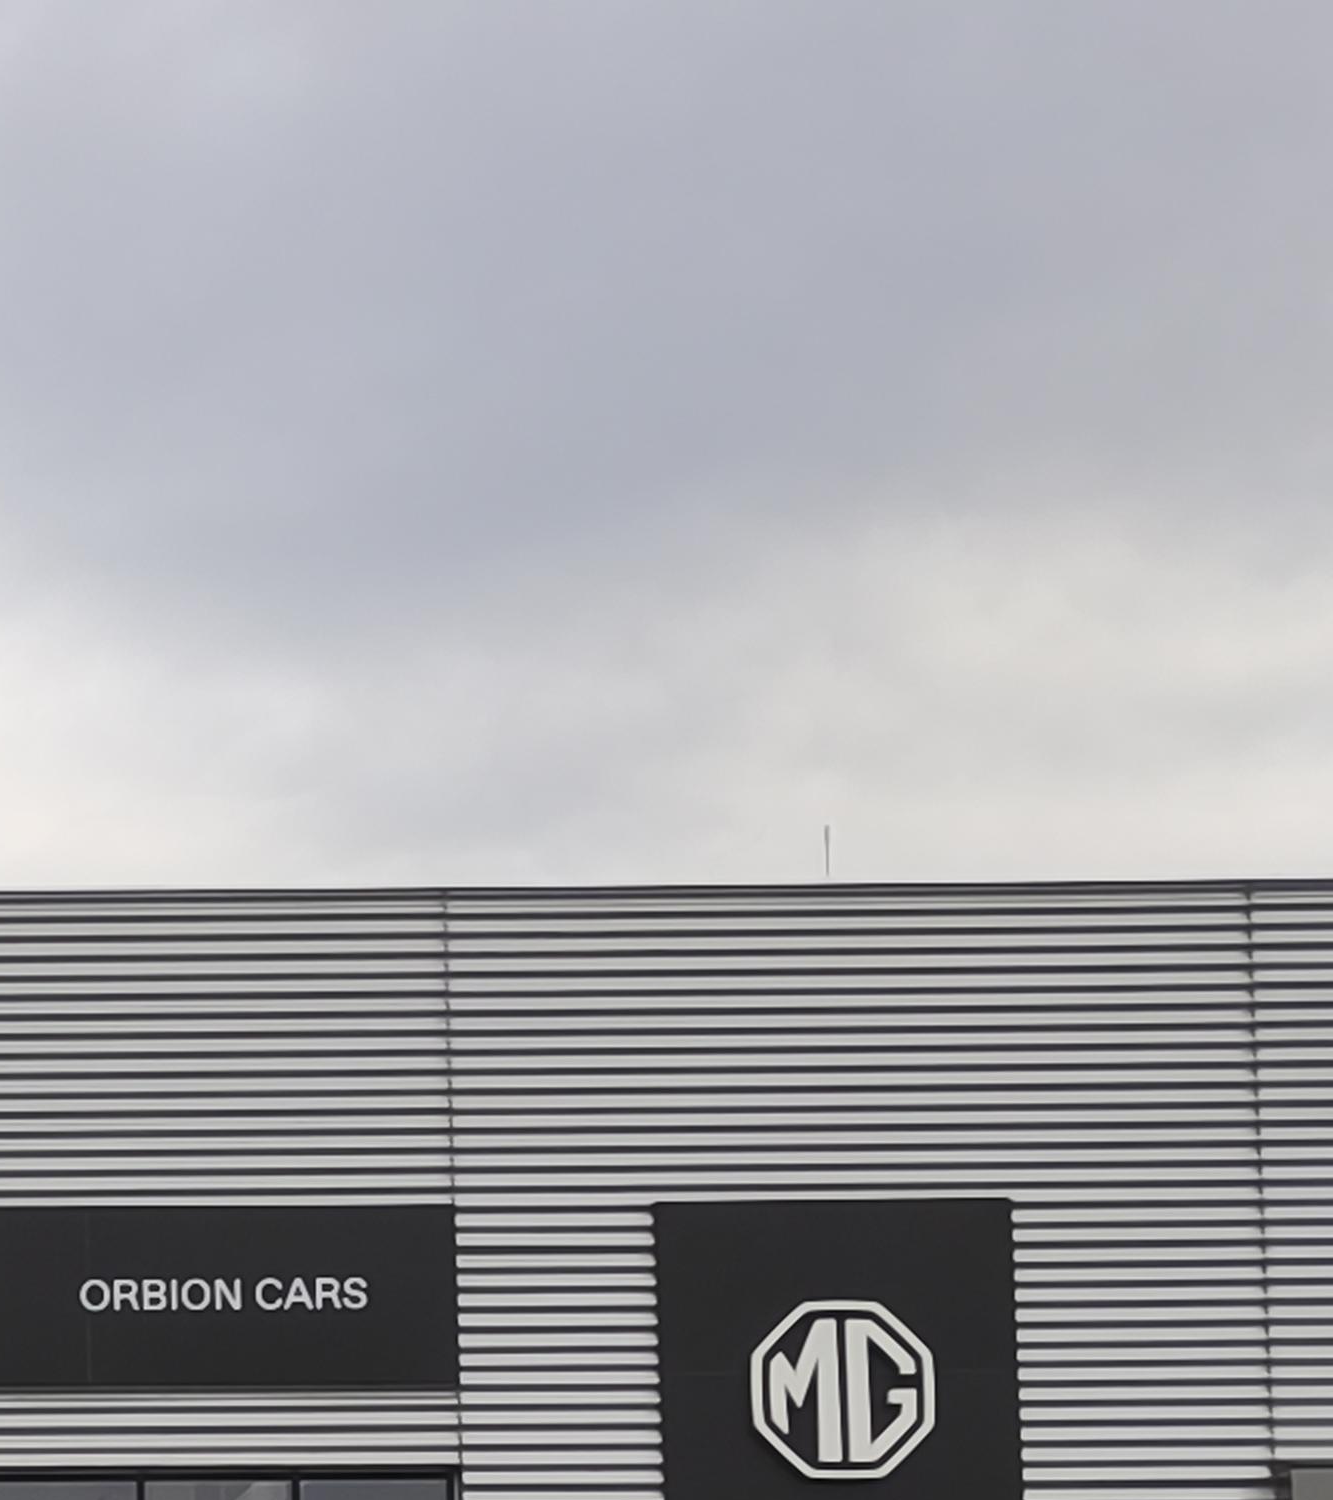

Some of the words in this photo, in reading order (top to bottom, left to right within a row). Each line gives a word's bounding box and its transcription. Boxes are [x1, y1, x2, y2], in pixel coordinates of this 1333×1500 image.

[78, 1278, 243, 1312] ORBION
[254, 1276, 369, 1311] CARS
[769, 1316, 918, 1464] MG
